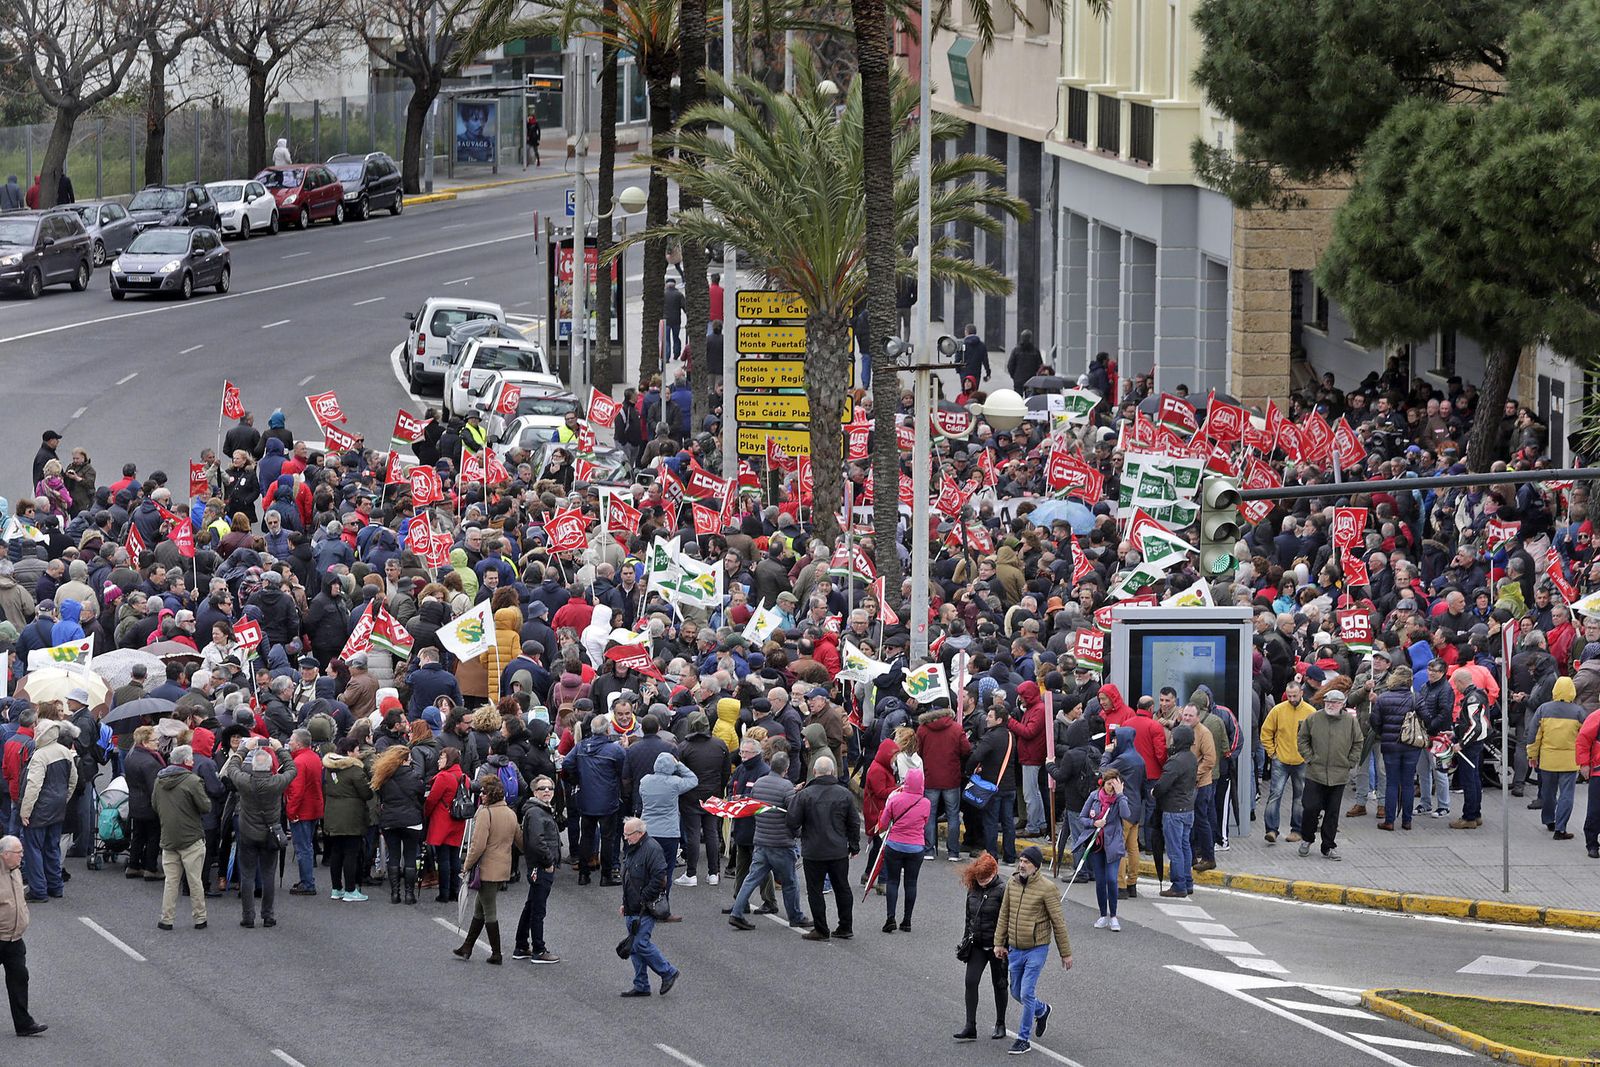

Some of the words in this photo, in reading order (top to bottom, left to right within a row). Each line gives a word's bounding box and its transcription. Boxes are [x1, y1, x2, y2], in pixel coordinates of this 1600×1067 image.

[740, 305, 763, 315] Tryp
[740, 375, 765, 383] Regio
[594, 400, 613, 414] UGT
[739, 409, 756, 418] Spa
[740, 442, 766, 452] Playa
[772, 443, 809, 453] ictoria
[411, 524, 427, 541] UGT
[558, 519, 580, 539] UGT
